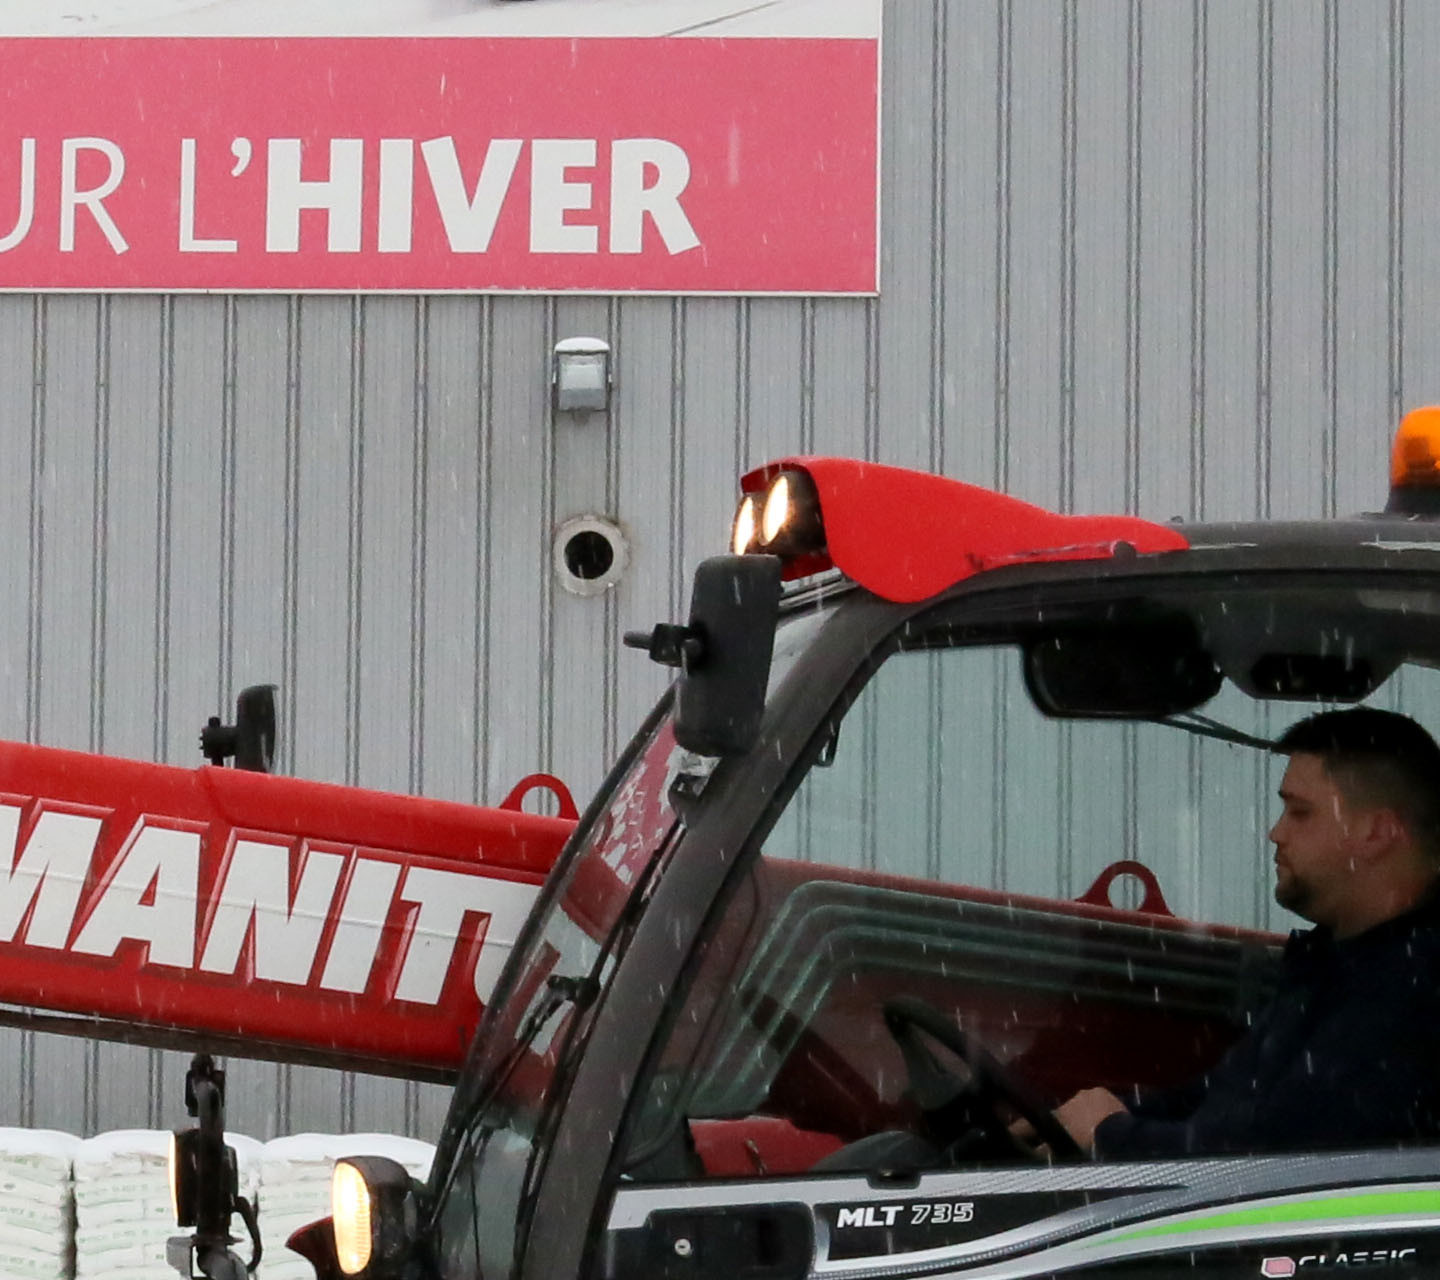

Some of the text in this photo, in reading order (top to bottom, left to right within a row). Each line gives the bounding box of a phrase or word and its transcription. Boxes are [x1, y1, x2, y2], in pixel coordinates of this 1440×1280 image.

[179, 135, 701, 255] L'HIVER
[836, 1202, 974, 1228] MLT 735
